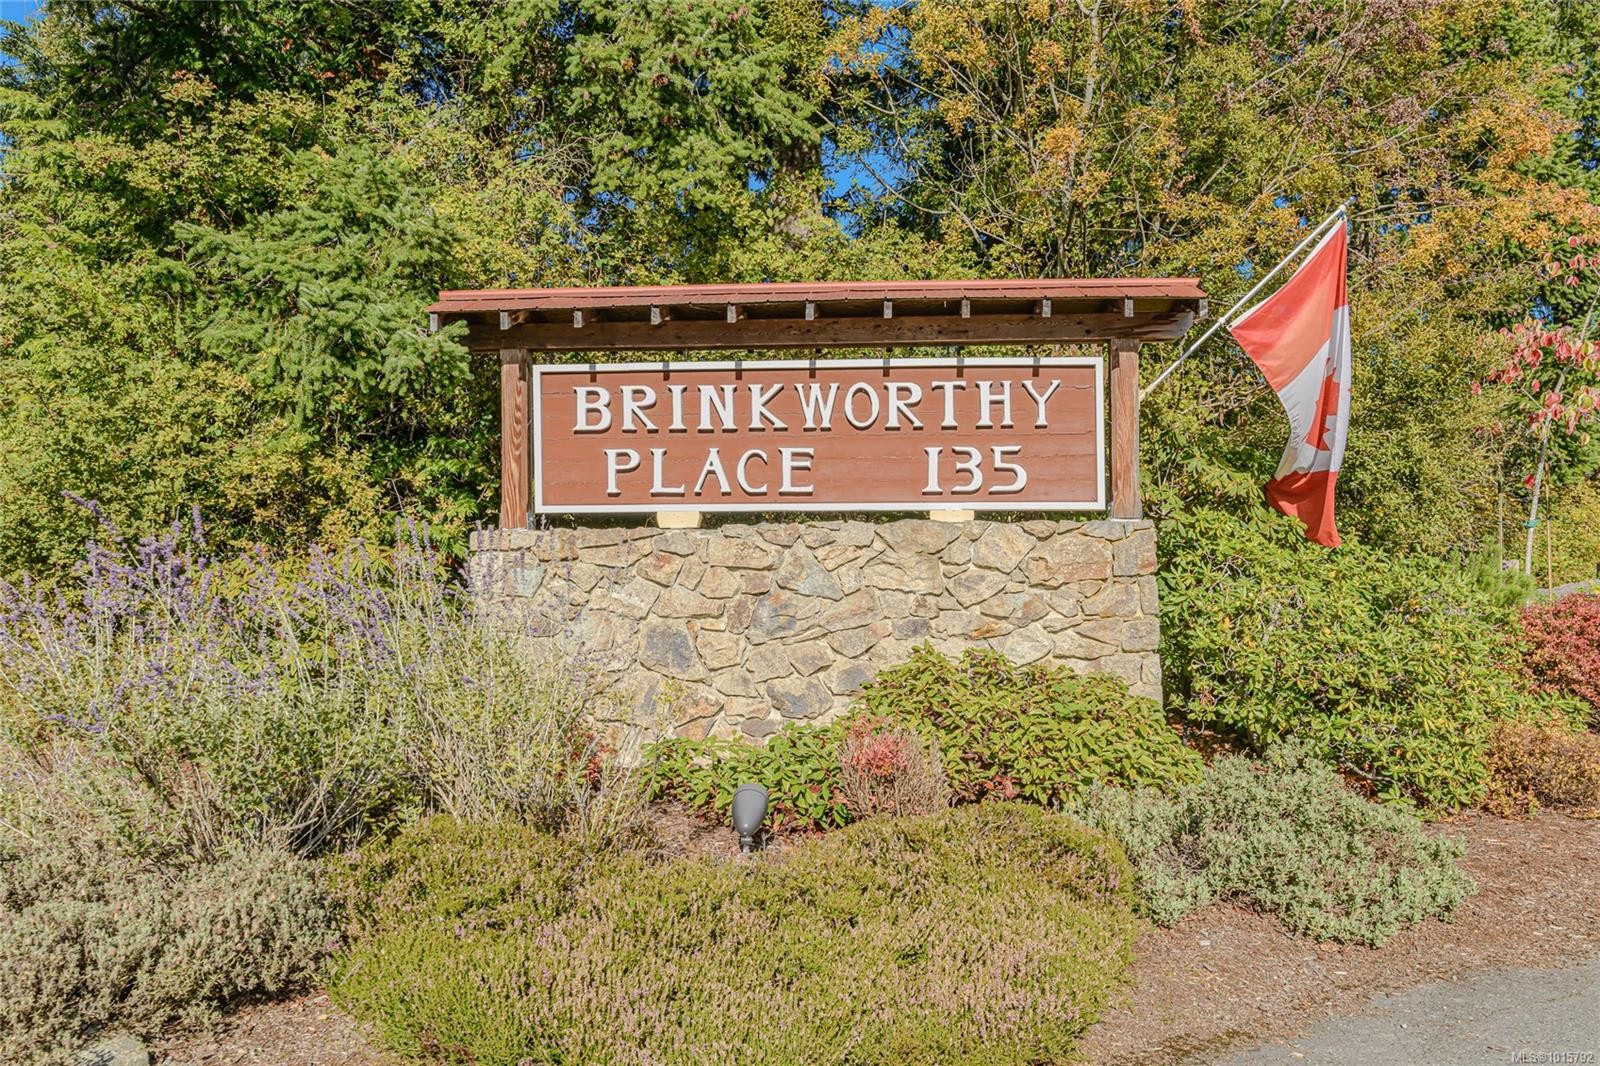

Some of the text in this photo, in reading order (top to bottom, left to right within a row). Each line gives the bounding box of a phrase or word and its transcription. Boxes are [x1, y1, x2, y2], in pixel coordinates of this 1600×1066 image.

[572, 379, 1062, 432] BRINKWORTHY
[602, 445, 1028, 495] PLACE 135
